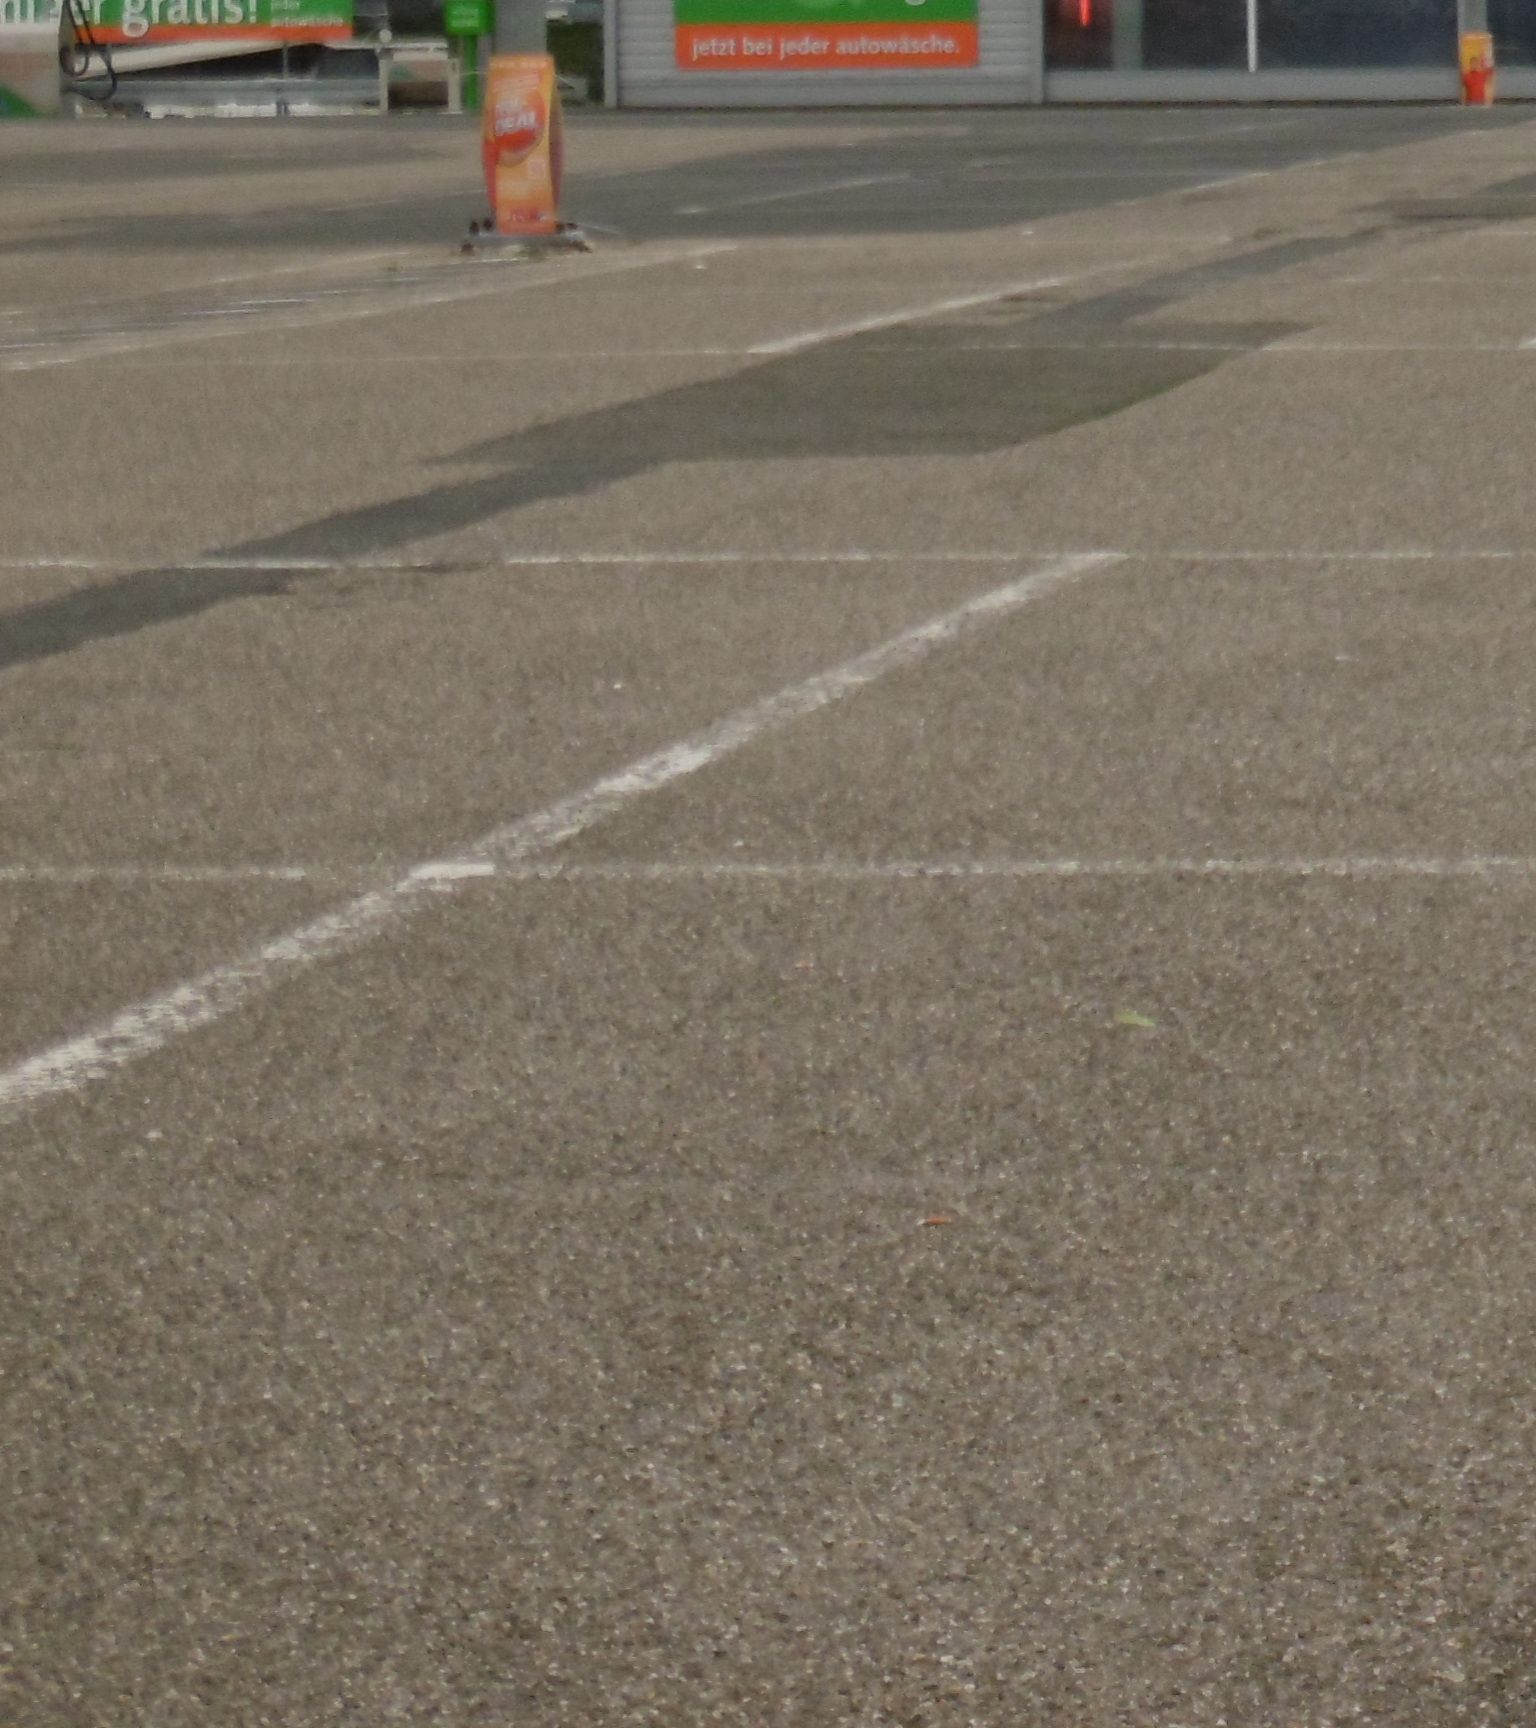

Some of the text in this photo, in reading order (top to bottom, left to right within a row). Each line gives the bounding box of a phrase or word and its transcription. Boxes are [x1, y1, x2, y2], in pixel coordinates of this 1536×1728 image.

[691, 36, 738, 62] jetzt
[742, 37, 774, 57] bei
[778, 35, 831, 60] jeder
